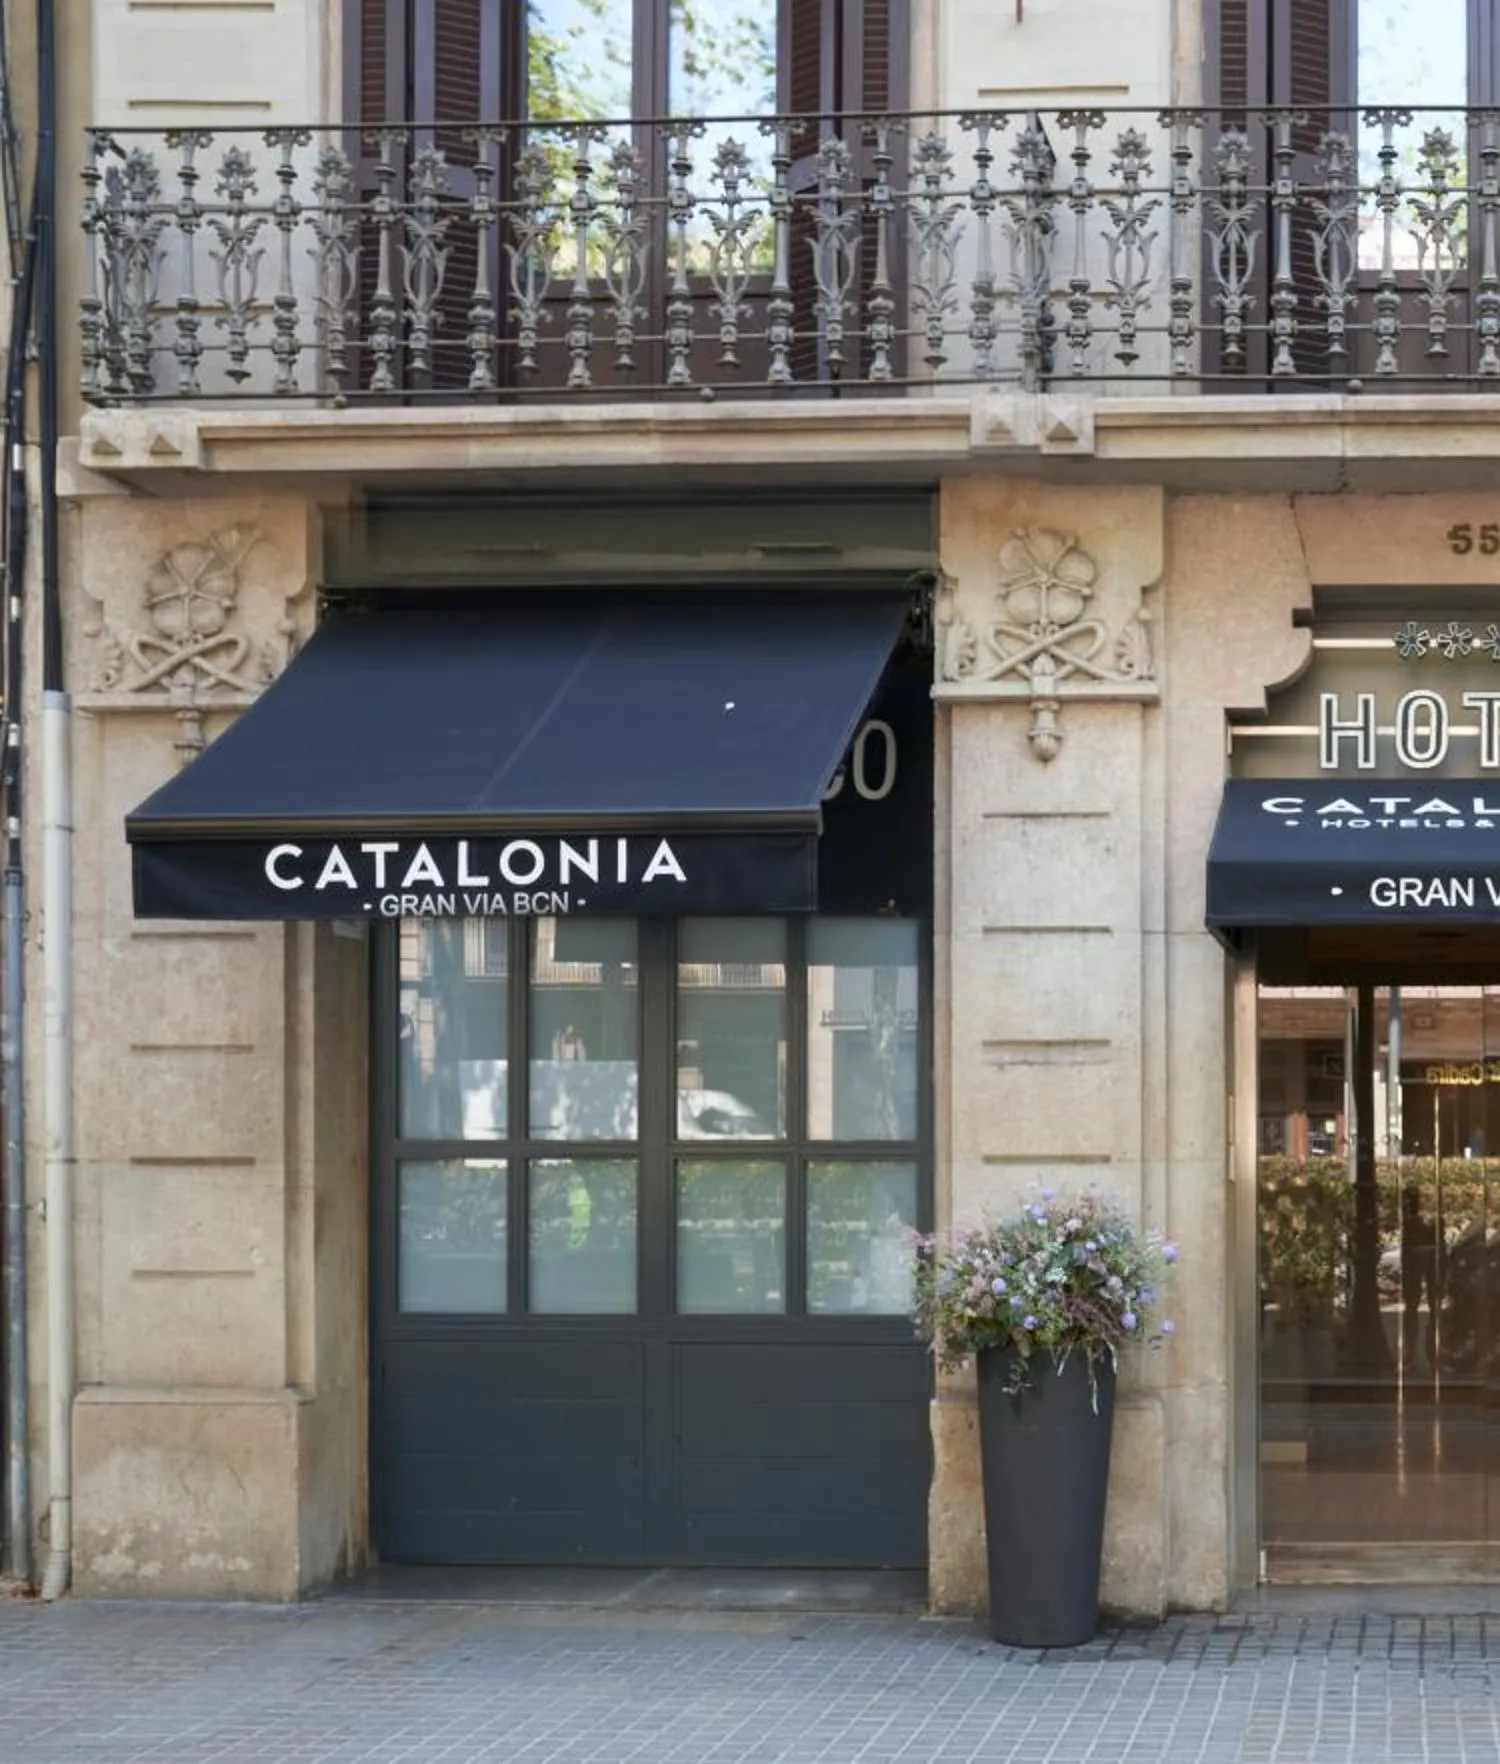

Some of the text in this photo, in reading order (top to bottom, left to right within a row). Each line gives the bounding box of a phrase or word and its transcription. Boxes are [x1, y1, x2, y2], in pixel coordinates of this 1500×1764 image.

[820, 719, 897, 801] 0
[264, 838, 688, 890] CATALONIA
[380, 892, 570, 918] GRAN VIA BCN
[1369, 877, 1475, 908] GRAN
